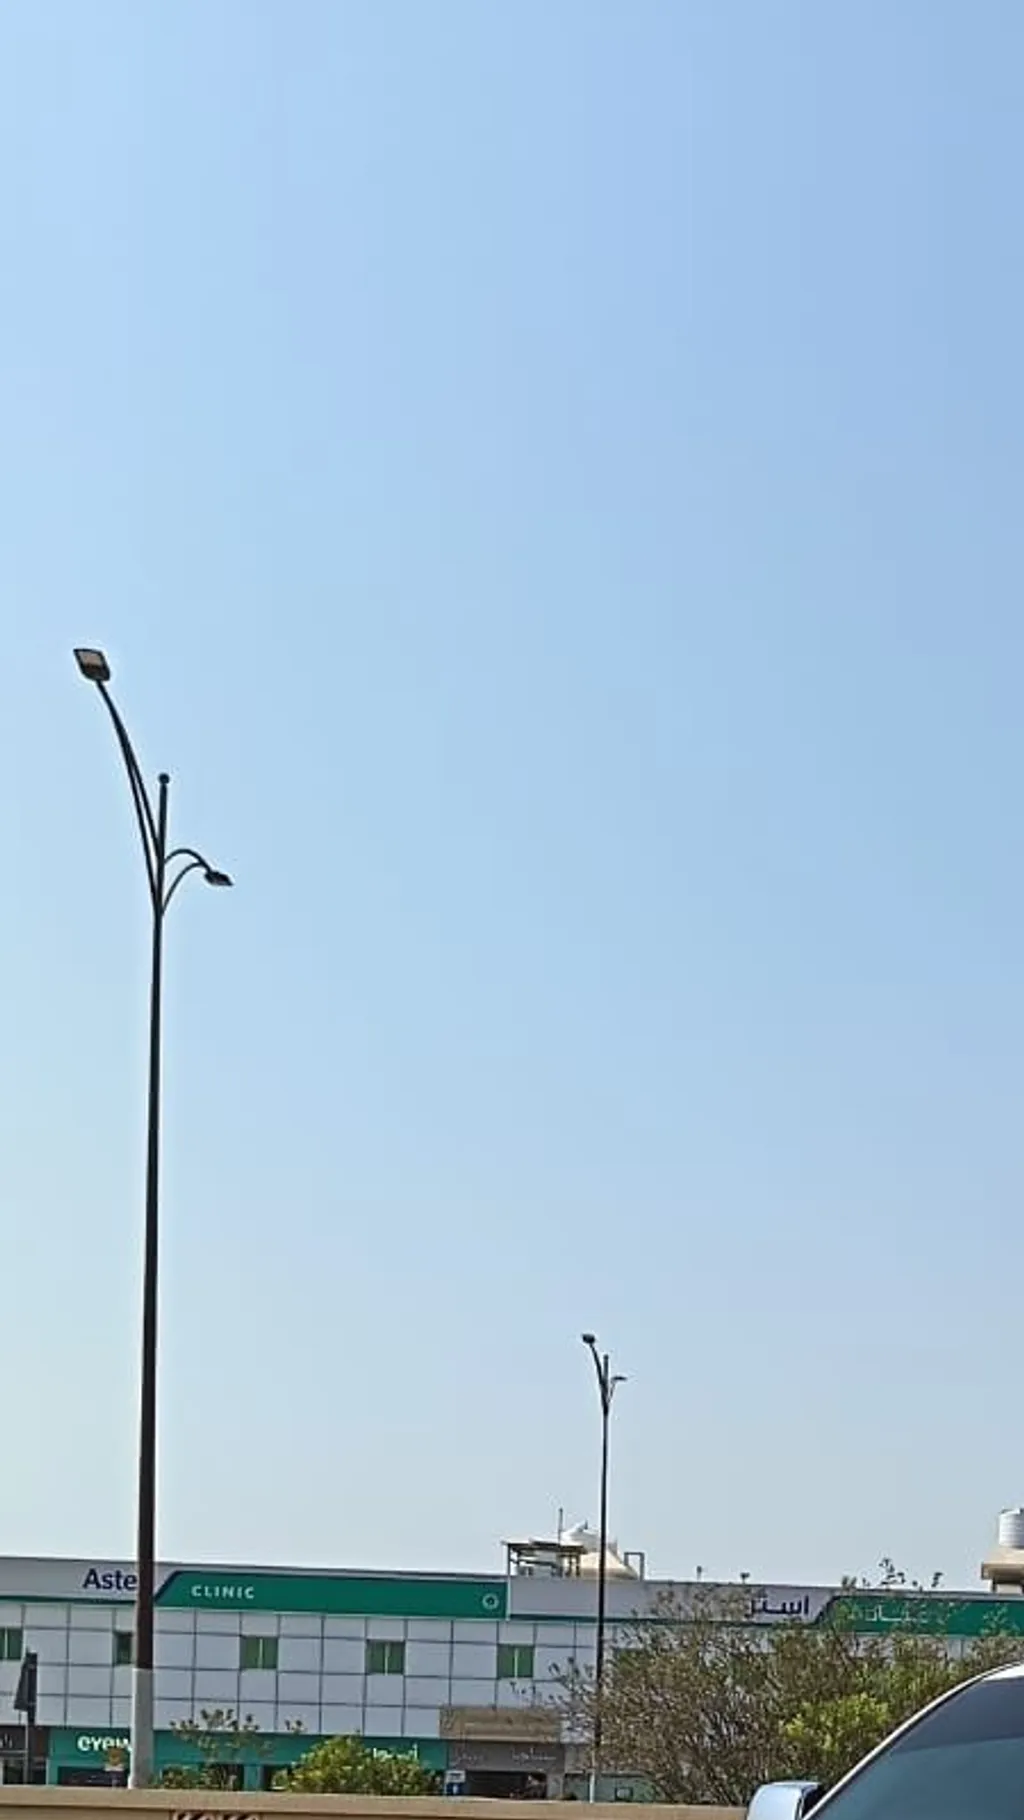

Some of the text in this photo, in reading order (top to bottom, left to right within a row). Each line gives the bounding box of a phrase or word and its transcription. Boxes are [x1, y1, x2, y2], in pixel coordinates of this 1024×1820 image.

[82, 1568, 138, 1591] Aste
[191, 1585, 254, 1599] CLINIC
[77, 1735, 133, 1752] eyew
